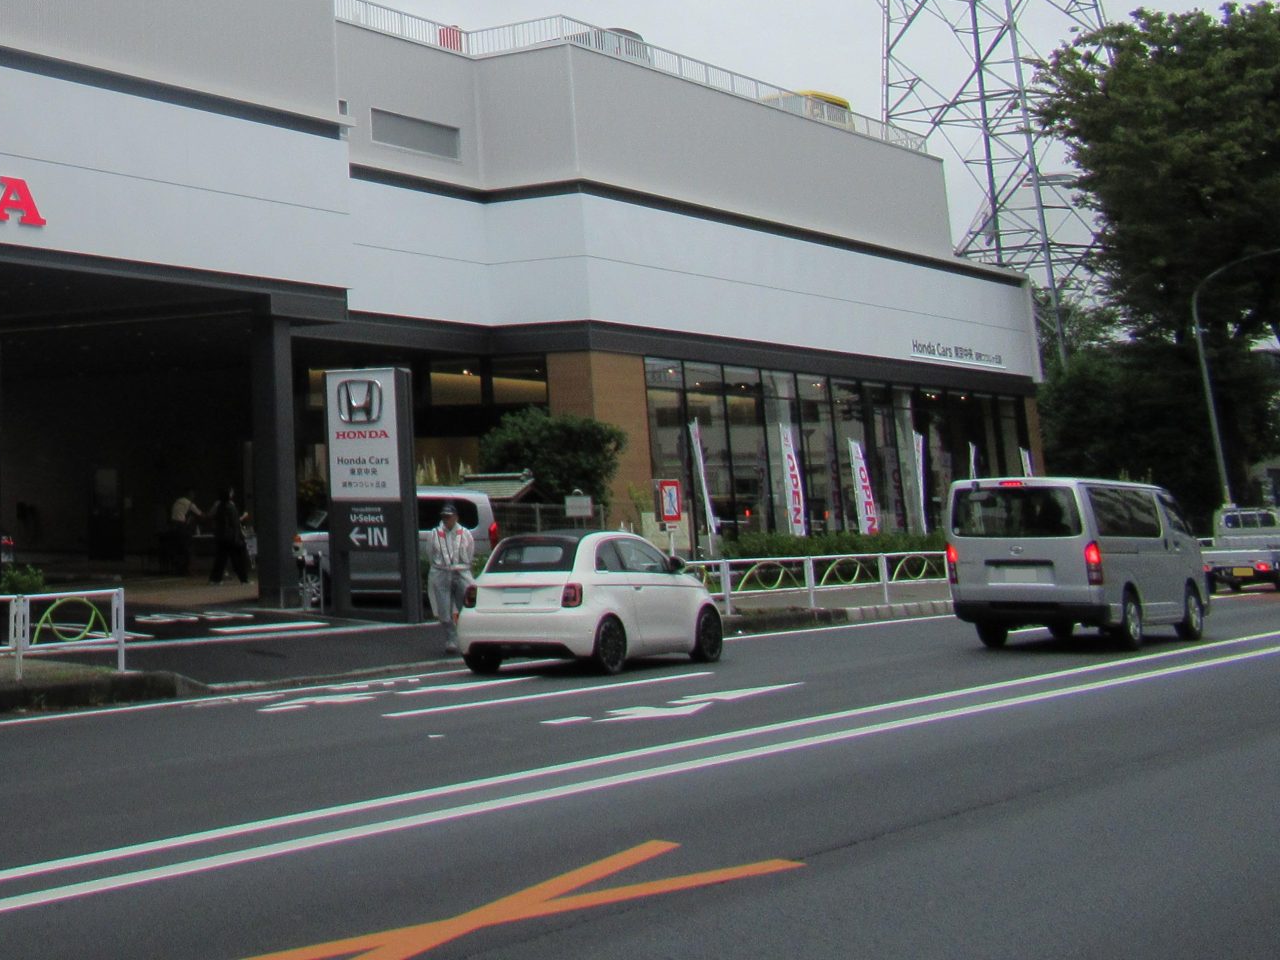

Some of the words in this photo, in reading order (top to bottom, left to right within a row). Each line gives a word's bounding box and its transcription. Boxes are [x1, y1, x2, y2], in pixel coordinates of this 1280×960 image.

[912, 339, 935, 355] Honda
[936, 343, 952, 357] Cars
[335, 430, 389, 440] HONDA
[336, 456, 367, 465] Honda
[368, 456, 389, 465] Cars
[787, 453, 802, 525] OPEN
[859, 466, 879, 534] OPEN
[367, 527, 389, 547] IN
